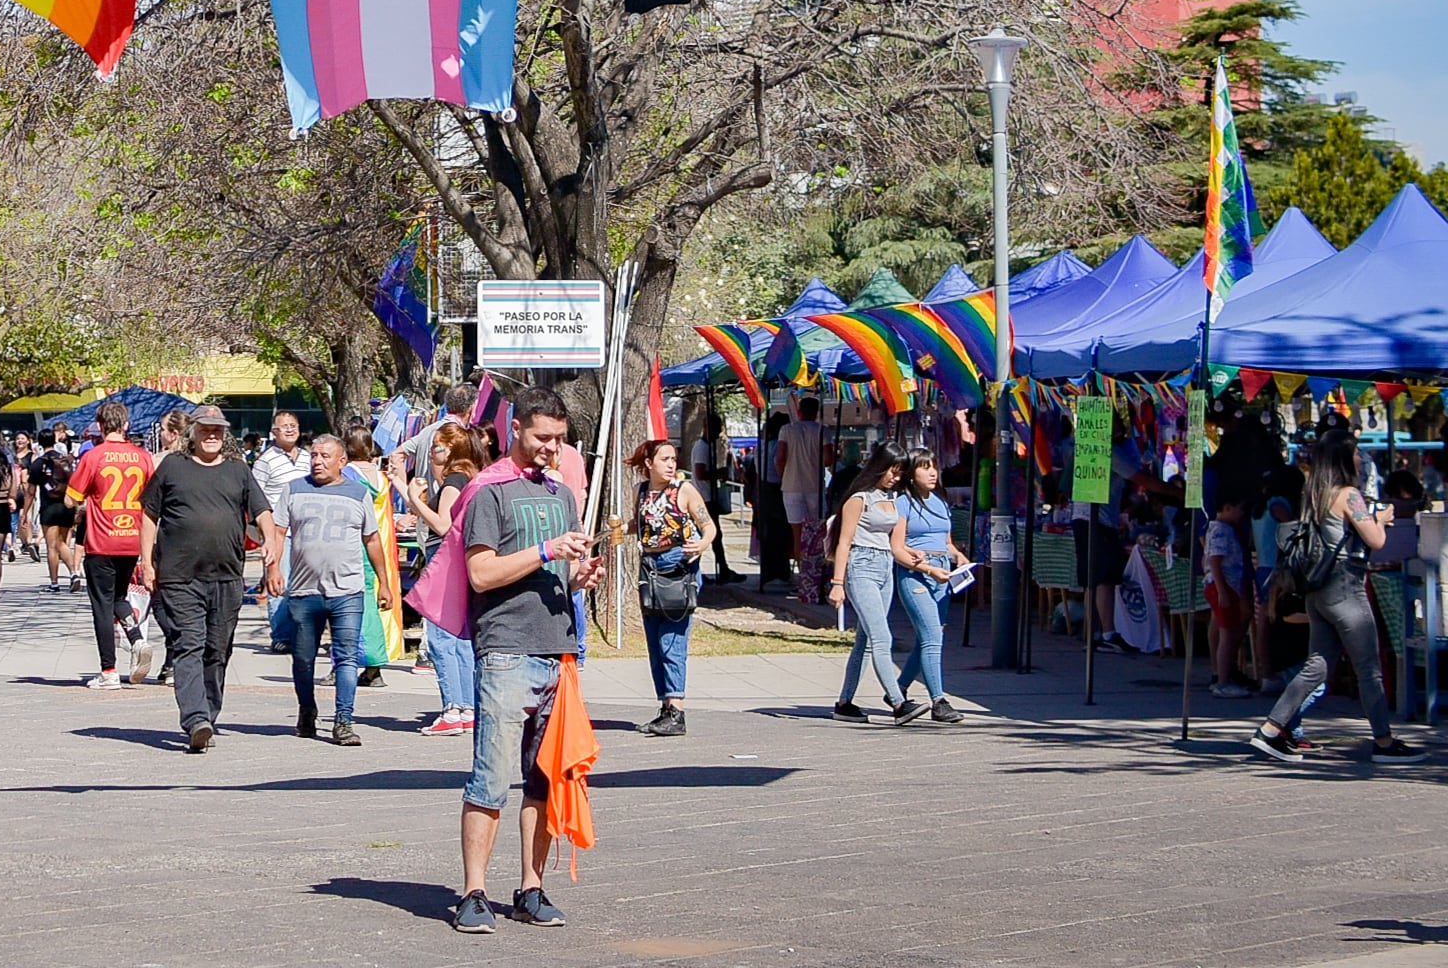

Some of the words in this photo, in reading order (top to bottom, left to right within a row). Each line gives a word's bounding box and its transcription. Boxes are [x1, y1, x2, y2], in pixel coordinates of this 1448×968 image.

[499, 311, 540, 321] "PASEO
[543, 311, 566, 321] POR
[568, 311, 583, 321] LA
[494, 324, 545, 334] MEMORIA
[547, 324, 588, 334] TRANS"
[1077, 416, 1109, 430] TAMALES
[103, 451, 140, 463] ZANIOLO
[99, 465, 145, 510] 22
[299, 502, 352, 543] 68
